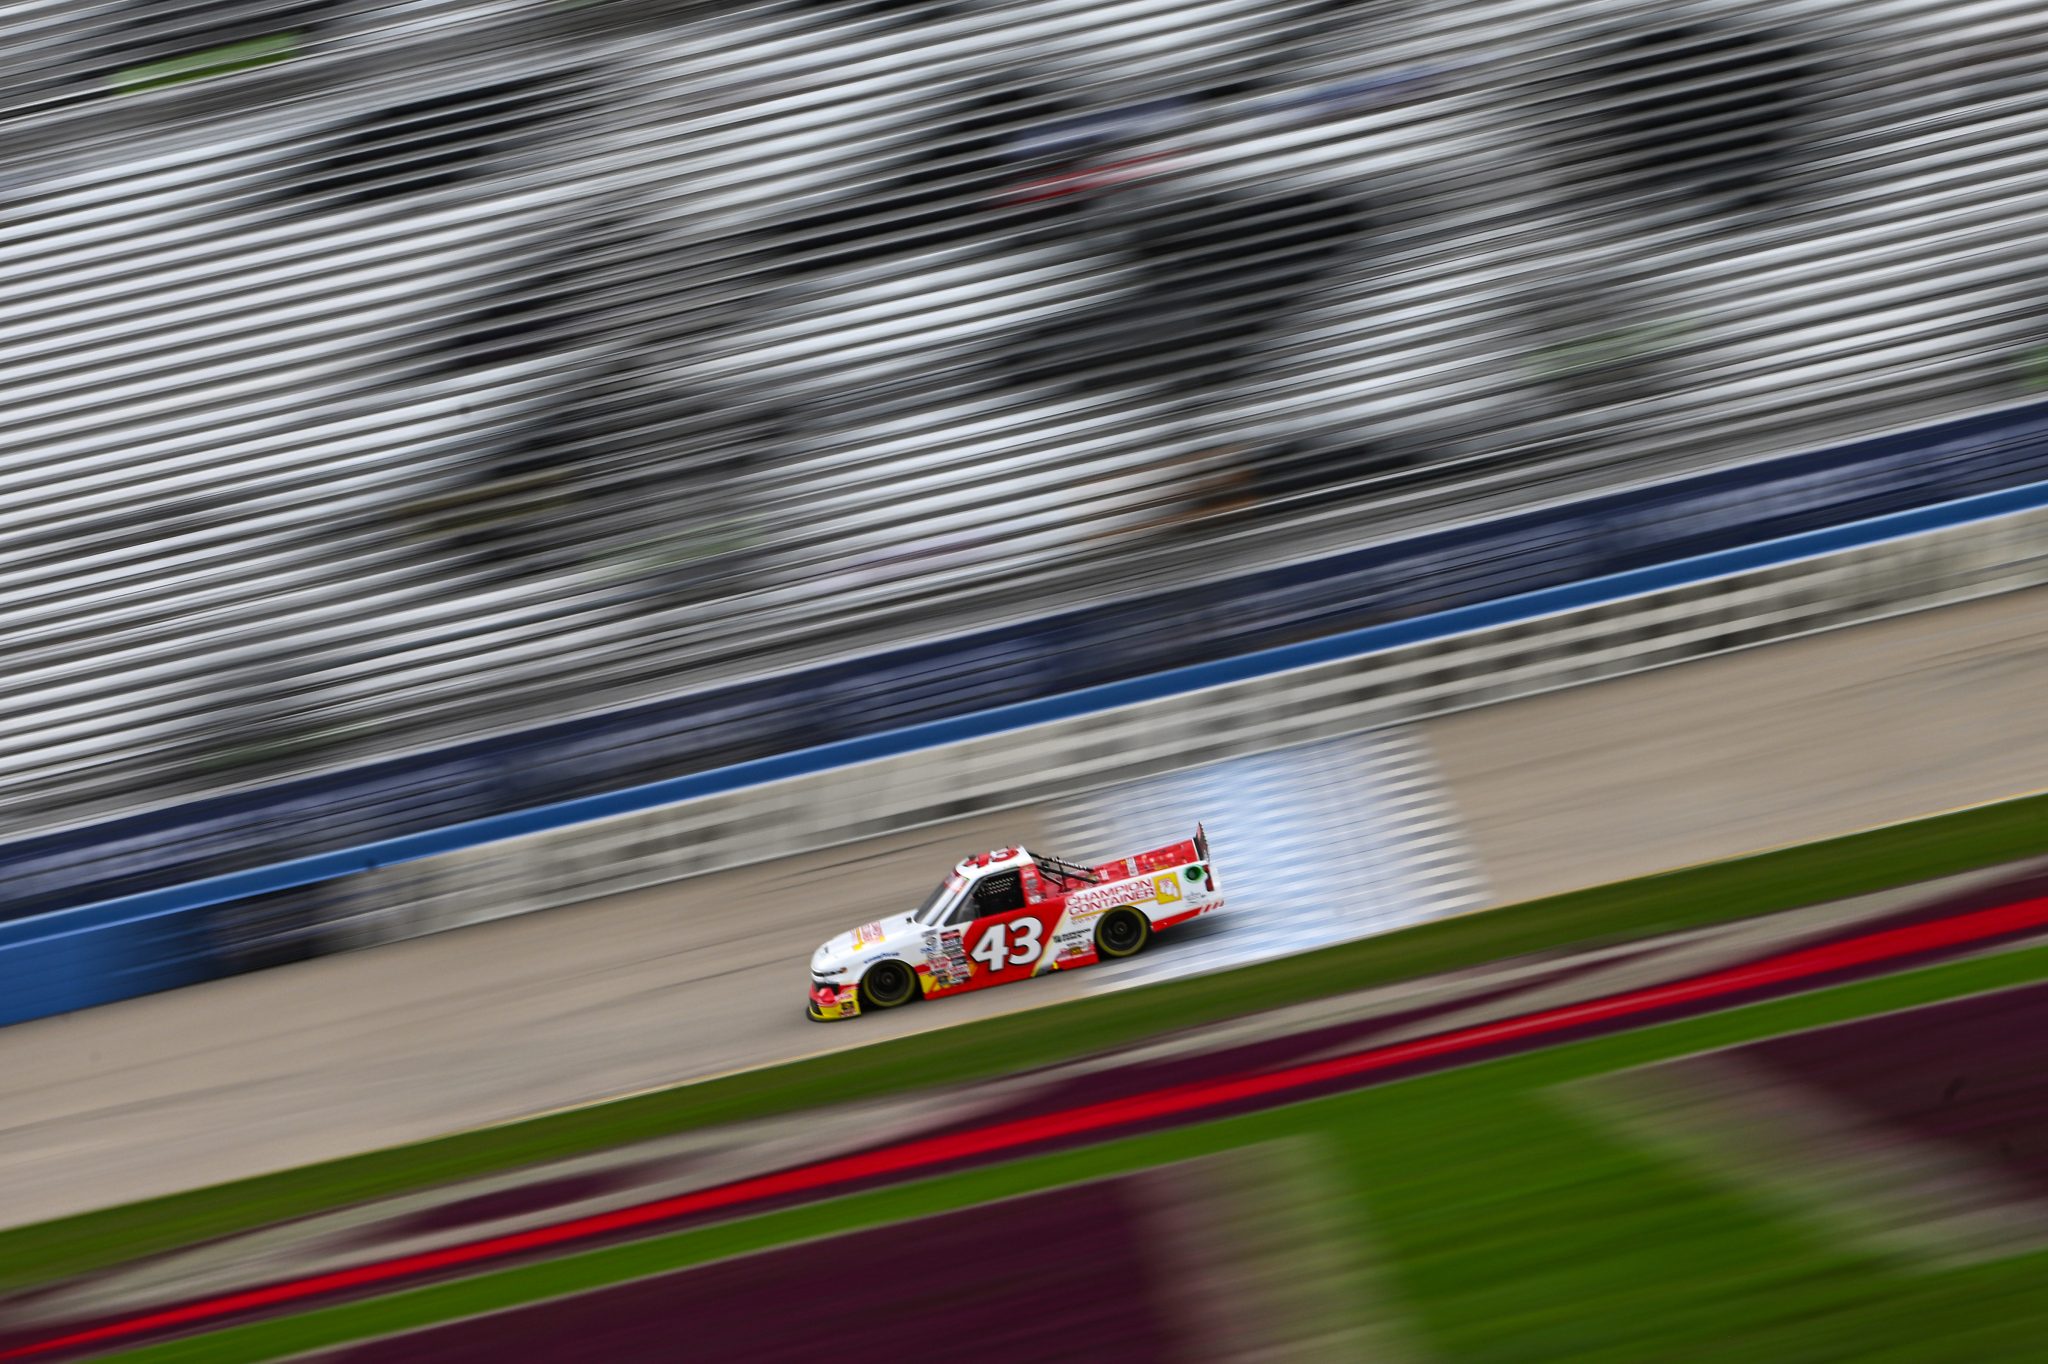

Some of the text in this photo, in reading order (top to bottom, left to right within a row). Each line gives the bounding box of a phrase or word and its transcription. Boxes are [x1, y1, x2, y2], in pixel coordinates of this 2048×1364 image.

[1067, 879, 1153, 906] CHAMPION
[1069, 888, 1156, 915] CONTAINER
[970, 916, 1043, 972] 43
